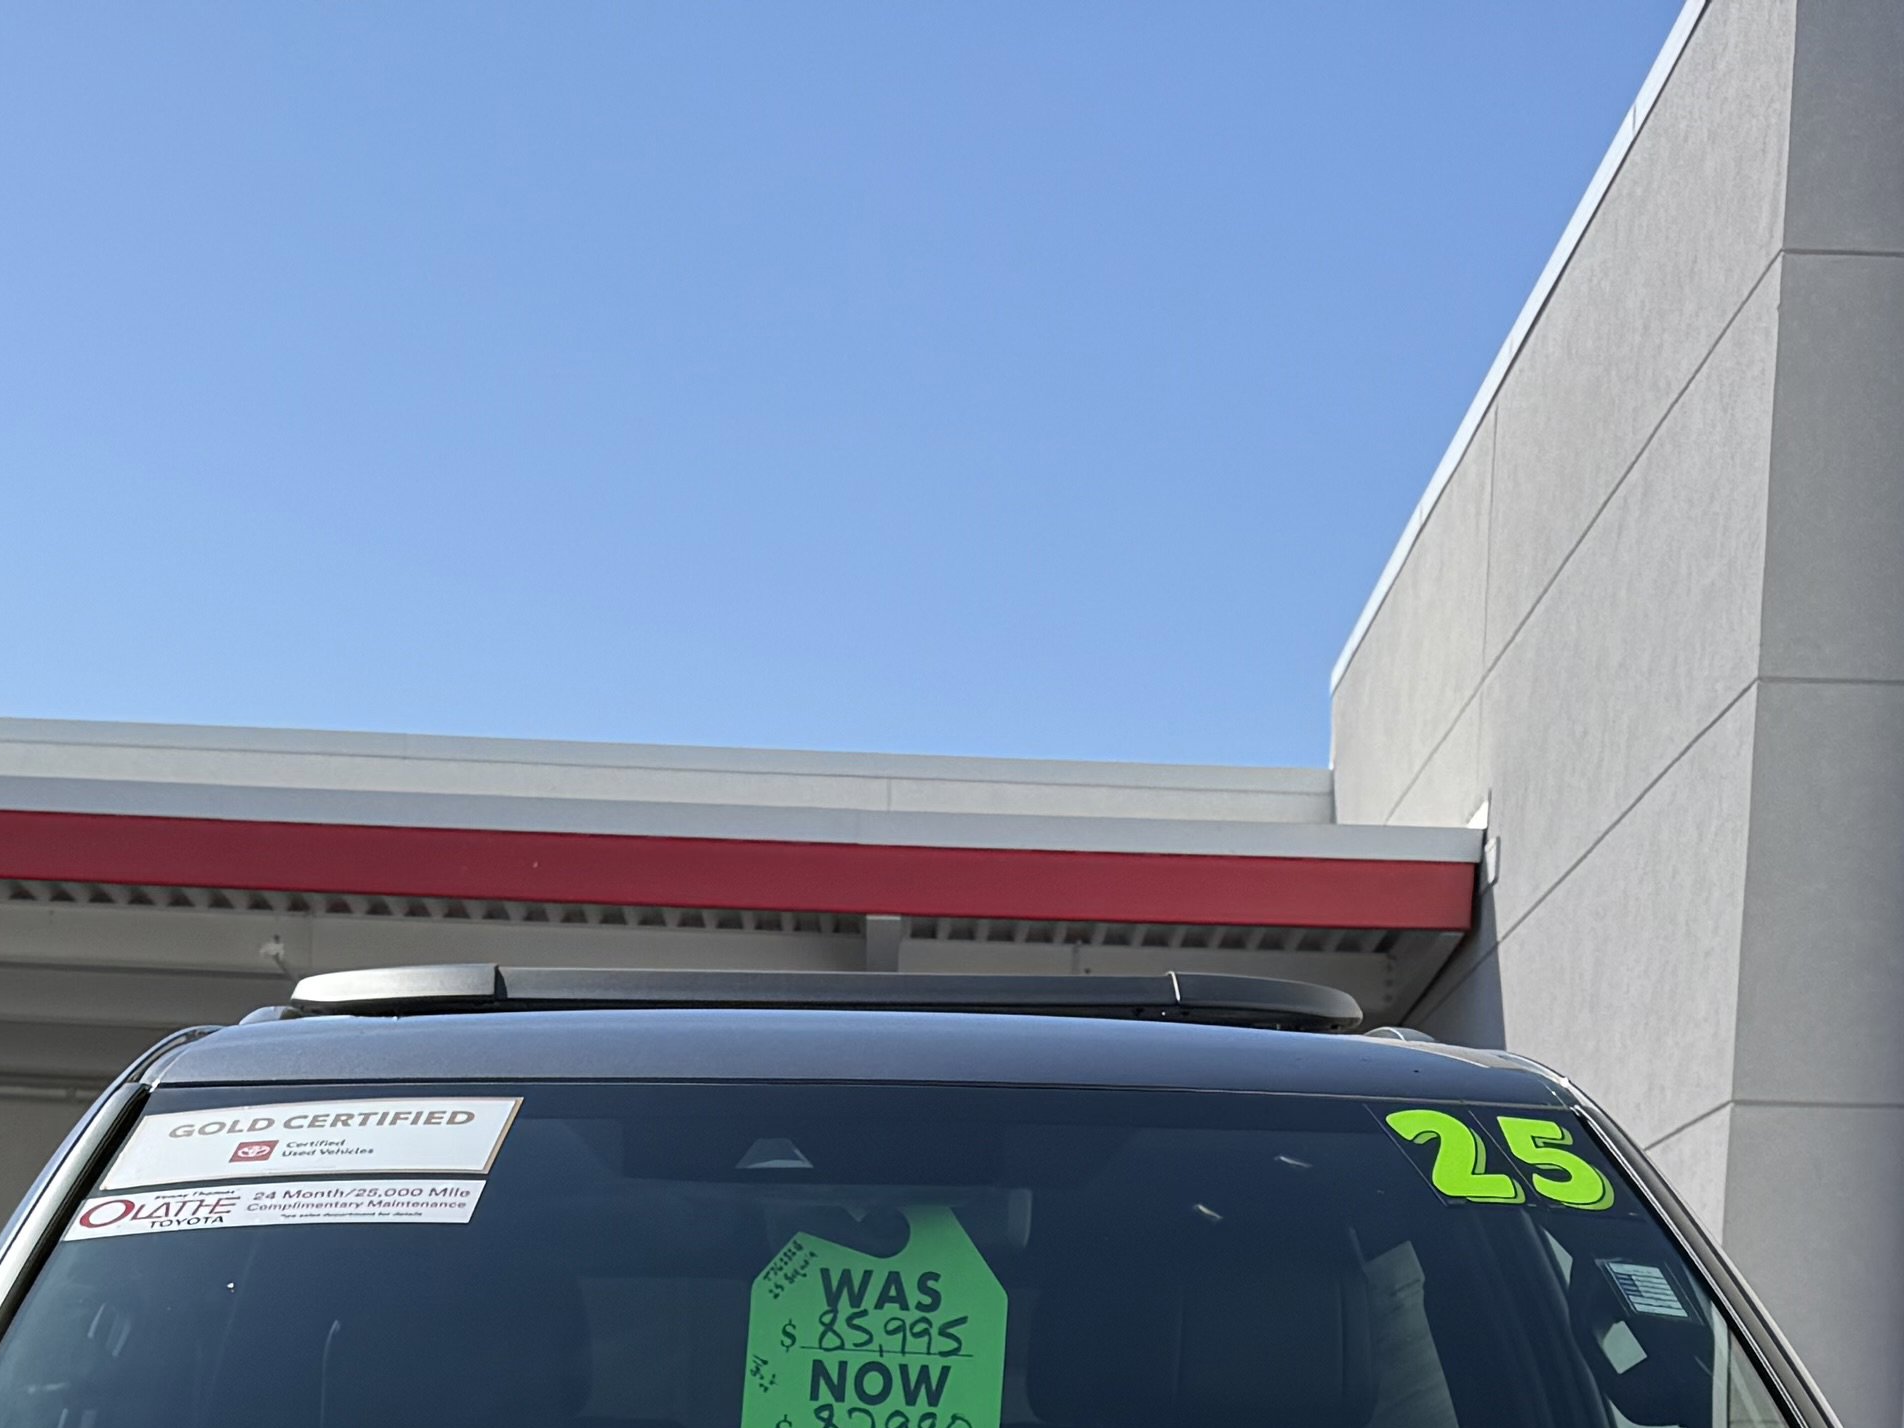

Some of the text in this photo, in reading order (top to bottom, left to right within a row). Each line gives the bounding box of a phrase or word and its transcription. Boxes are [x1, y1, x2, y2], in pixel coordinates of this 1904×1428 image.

[168, 1109, 476, 1139] GOLD CERTIFIED
[282, 1146, 374, 1158] Used Vehicles
[286, 1138, 346, 1148] Certified
[1385, 1109, 1615, 1210] 25
[246, 1199, 467, 1212] Complimentary Maintenance
[253, 1190, 275, 1200] 24
[428, 1186, 471, 1198] Mile
[79, 1195, 241, 1229] OLATHE
[149, 1215, 224, 1229] TOYOTA
[819, 1267, 943, 1312] WAS
[817, 1308, 969, 1357] 85,995
[809, 1358, 952, 1408] NOW
